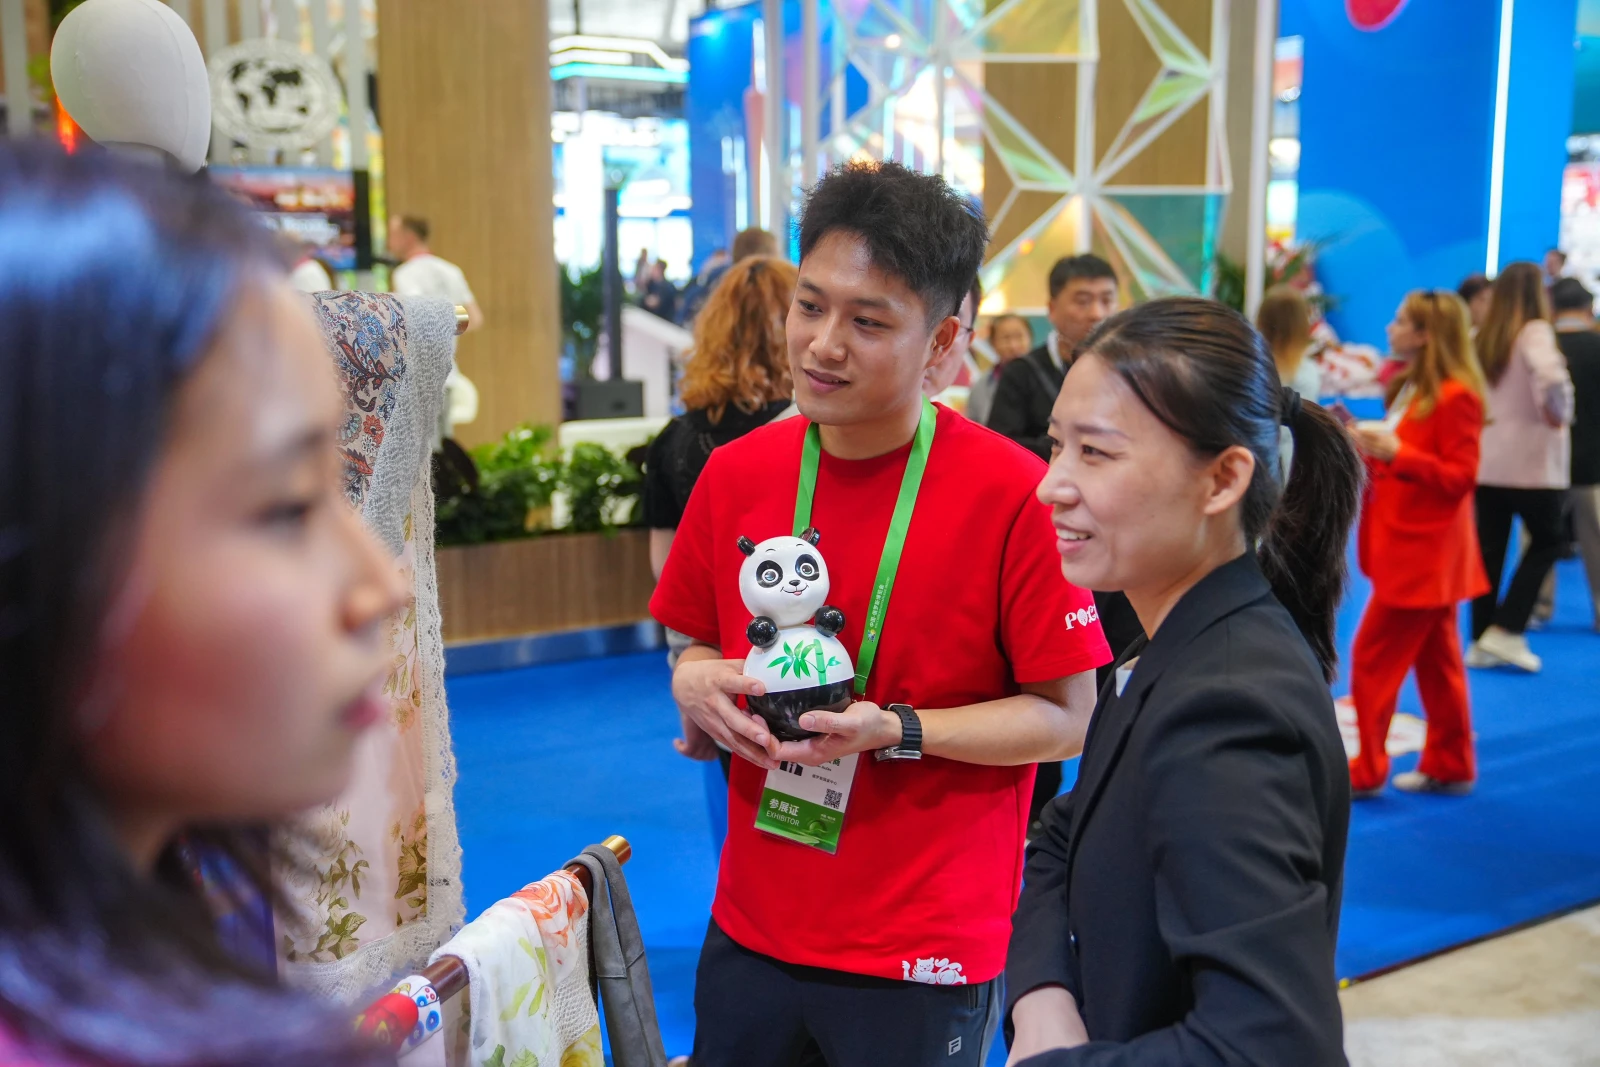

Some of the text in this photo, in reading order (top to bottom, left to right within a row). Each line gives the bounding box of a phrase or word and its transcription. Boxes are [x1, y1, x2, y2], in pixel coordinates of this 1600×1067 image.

[769, 798, 799, 816] 参展证
[766, 811, 799, 826] EXHIBITOR
